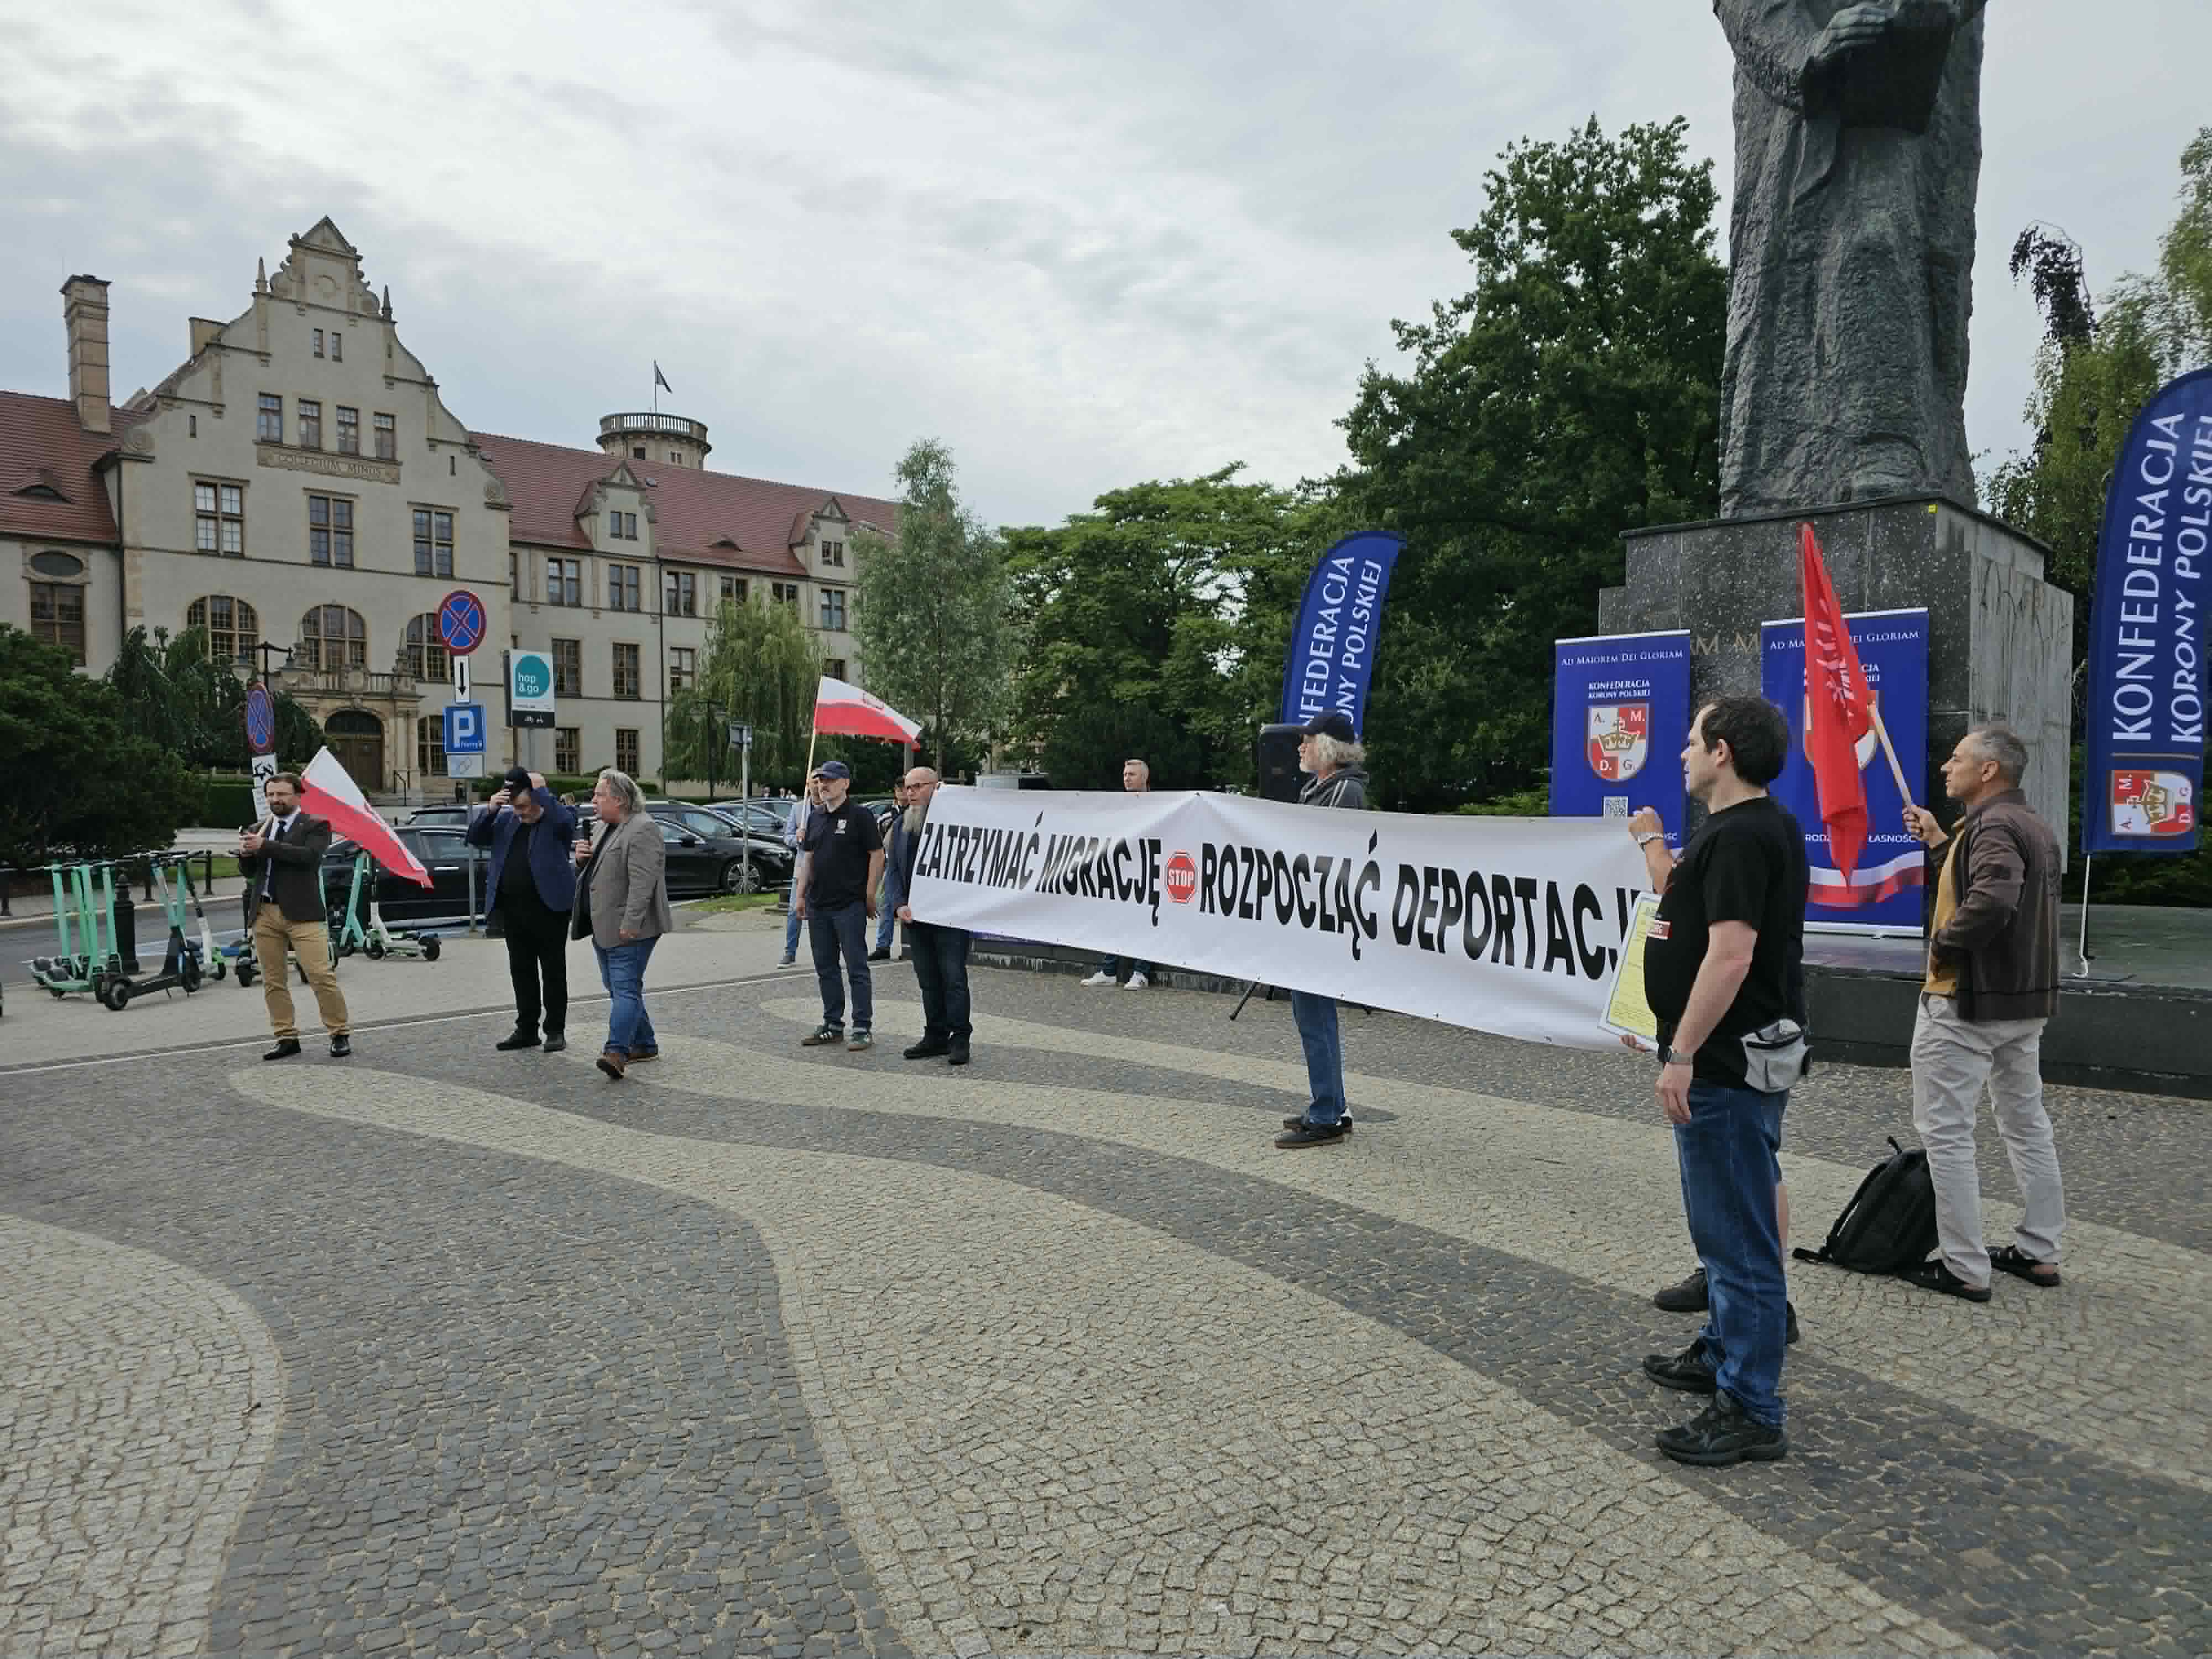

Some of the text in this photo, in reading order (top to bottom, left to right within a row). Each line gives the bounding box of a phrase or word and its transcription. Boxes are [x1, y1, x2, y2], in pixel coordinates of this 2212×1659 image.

[2112, 413, 2185, 740] KONFEDERACJA
[1342, 560, 1383, 669] POLSKIEJ
[1298, 556, 1355, 726] FEDERACJA
[1866, 630, 1919, 642] GLORIAM
[1770, 641, 1785, 650] AD
[1561, 649, 1683, 666] AD MAIOREM DEI GLORIAM
[2171, 588, 2203, 743] KORONY
[518, 672, 536, 684] hop
[1588, 680, 1651, 691] KONFEDERACJA
[518, 682, 539, 693] &go
[1588, 689, 1651, 699] KORONY POLSKIEJ
[452, 710, 474, 748] P
[915, 810, 1641, 981] ZATRZYMAĆ MIGRACJĘ STOP ROZPOCZĄĆ DEPORTACJ
